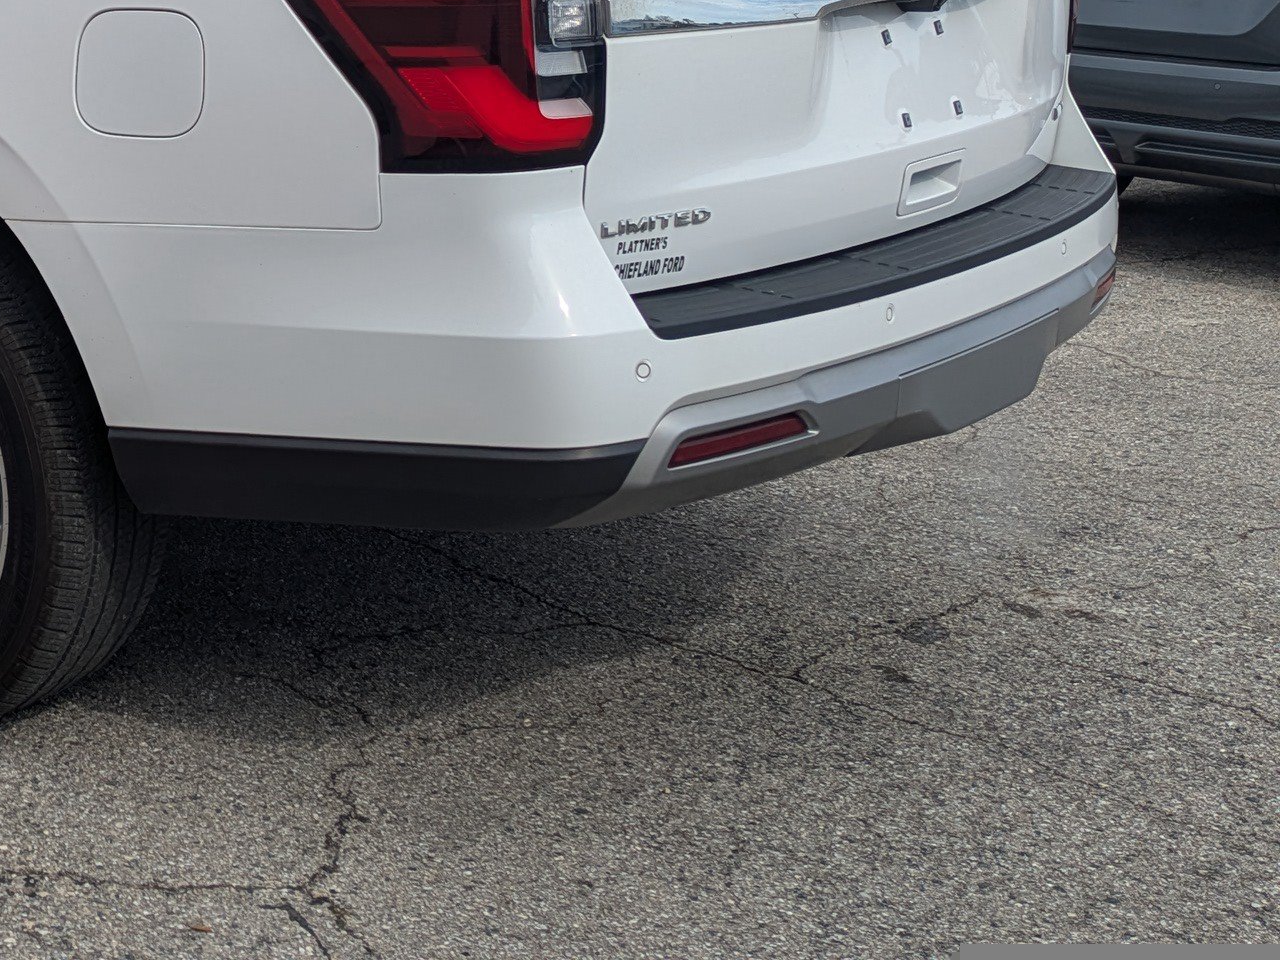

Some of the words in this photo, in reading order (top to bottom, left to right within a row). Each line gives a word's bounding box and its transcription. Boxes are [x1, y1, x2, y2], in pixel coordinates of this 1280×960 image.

[600, 208, 712, 239] LIMITED
[616, 237, 669, 255] PLATTNER'S
[661, 255, 685, 275] FORD
